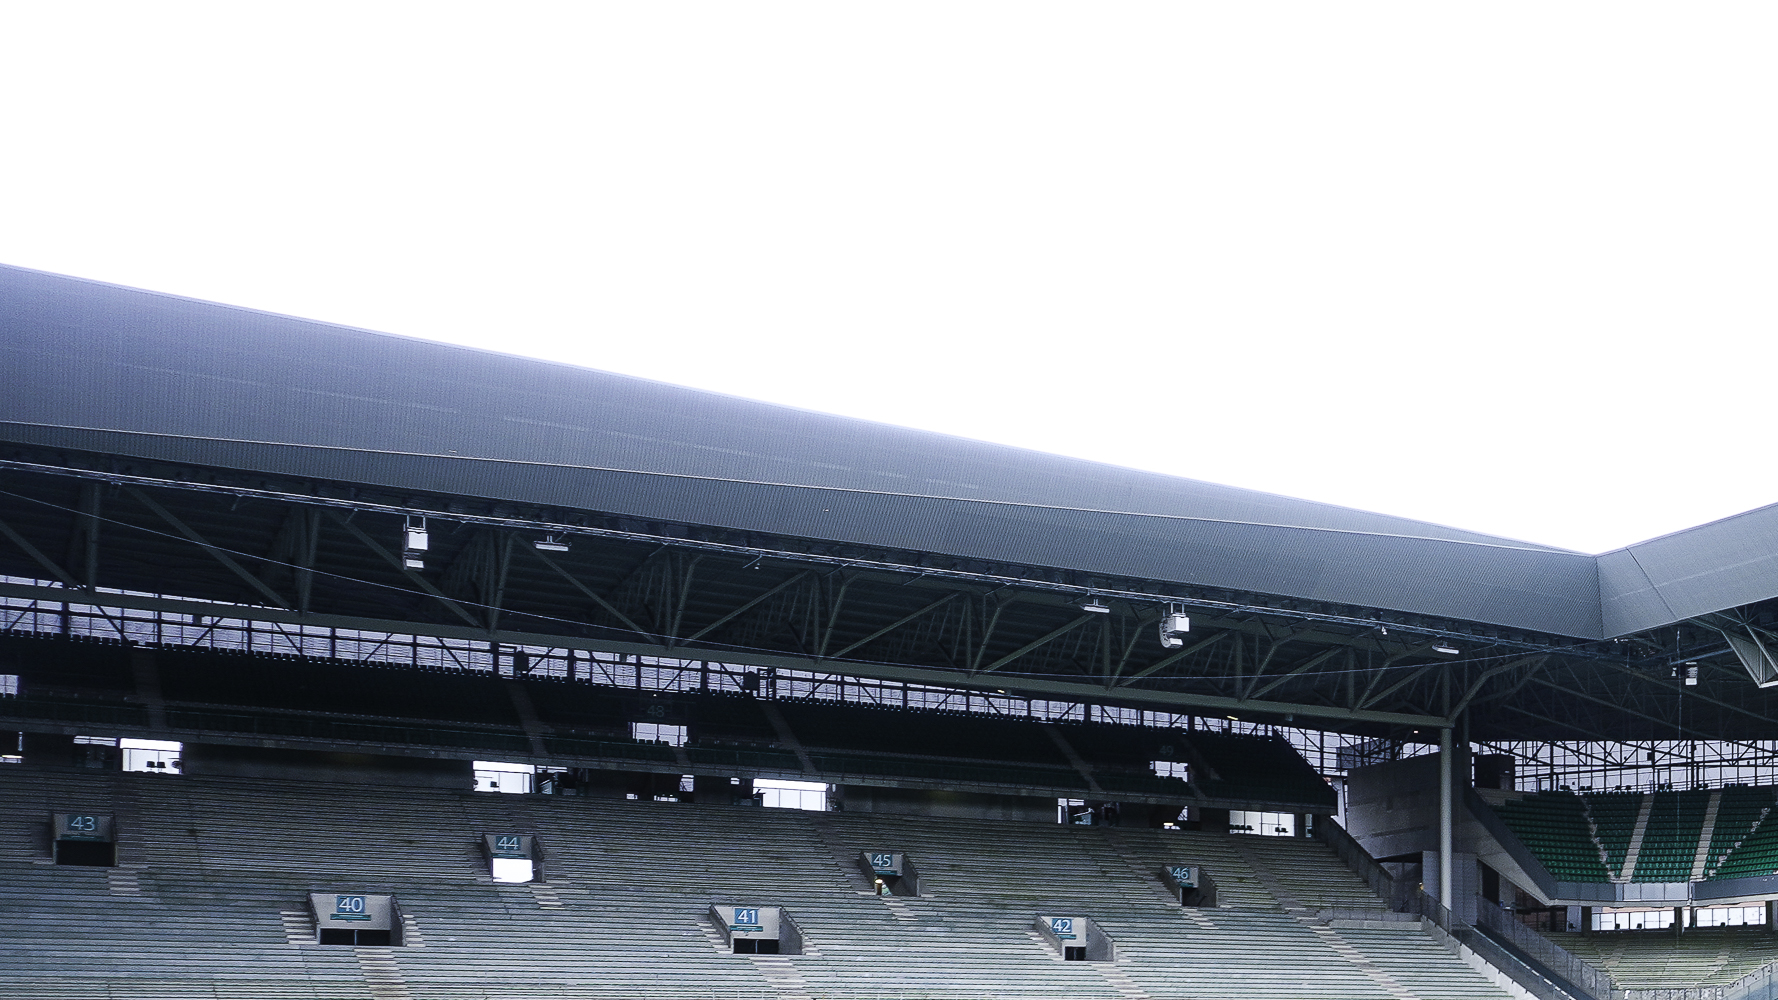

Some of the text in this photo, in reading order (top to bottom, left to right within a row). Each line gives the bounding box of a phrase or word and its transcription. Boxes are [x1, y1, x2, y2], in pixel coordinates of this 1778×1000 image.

[647, 705, 664, 718] 48
[1159, 745, 1174, 757] 49
[71, 816, 95, 831] 43
[497, 836, 519, 850] 44
[873, 854, 891, 867] 45
[1172, 867, 1189, 880] 46
[338, 897, 363, 912] 40
[737, 909, 756, 924] 41
[1052, 919, 1071, 932] 42
